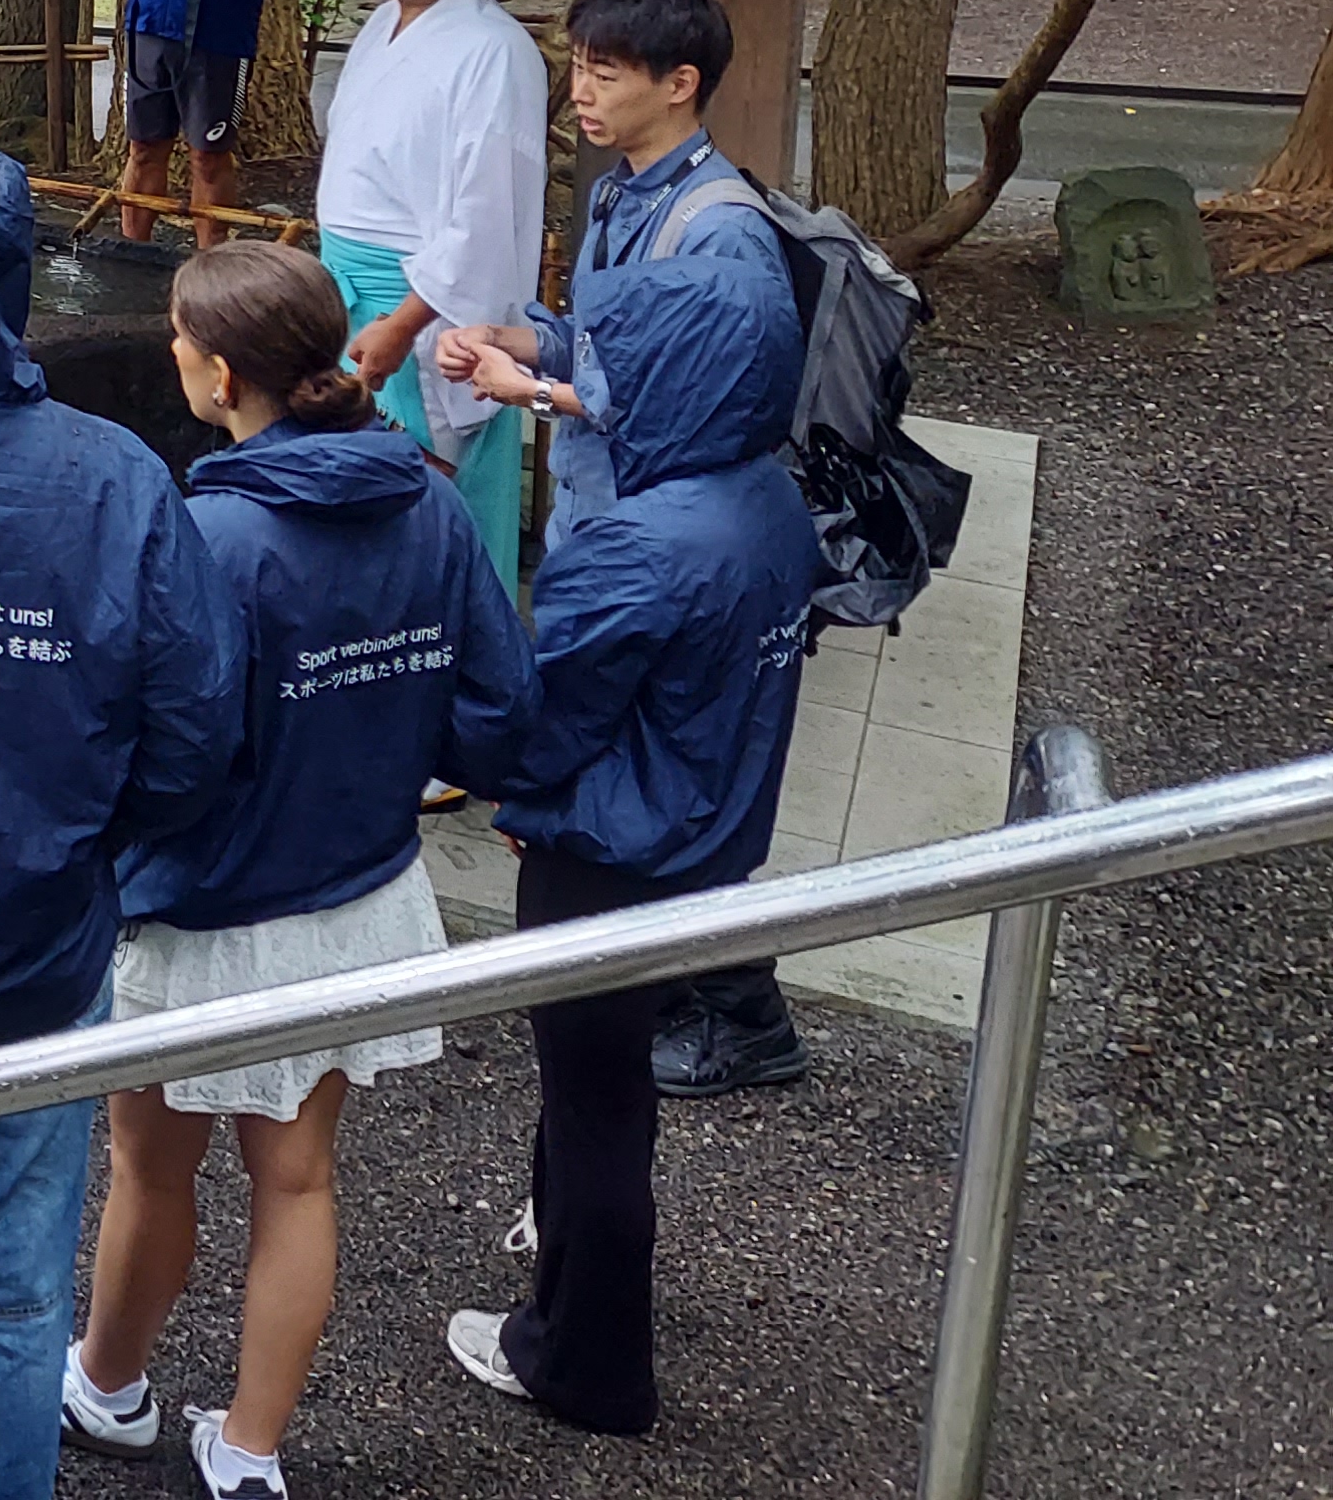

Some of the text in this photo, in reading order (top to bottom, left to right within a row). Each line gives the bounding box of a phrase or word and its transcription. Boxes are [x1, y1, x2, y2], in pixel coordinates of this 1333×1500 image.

[9, 607, 54, 628] uns!
[280, 644, 454, 700] スポーツは私たちを結ぶ
[297, 622, 443, 672] Sport verbindet uns!
